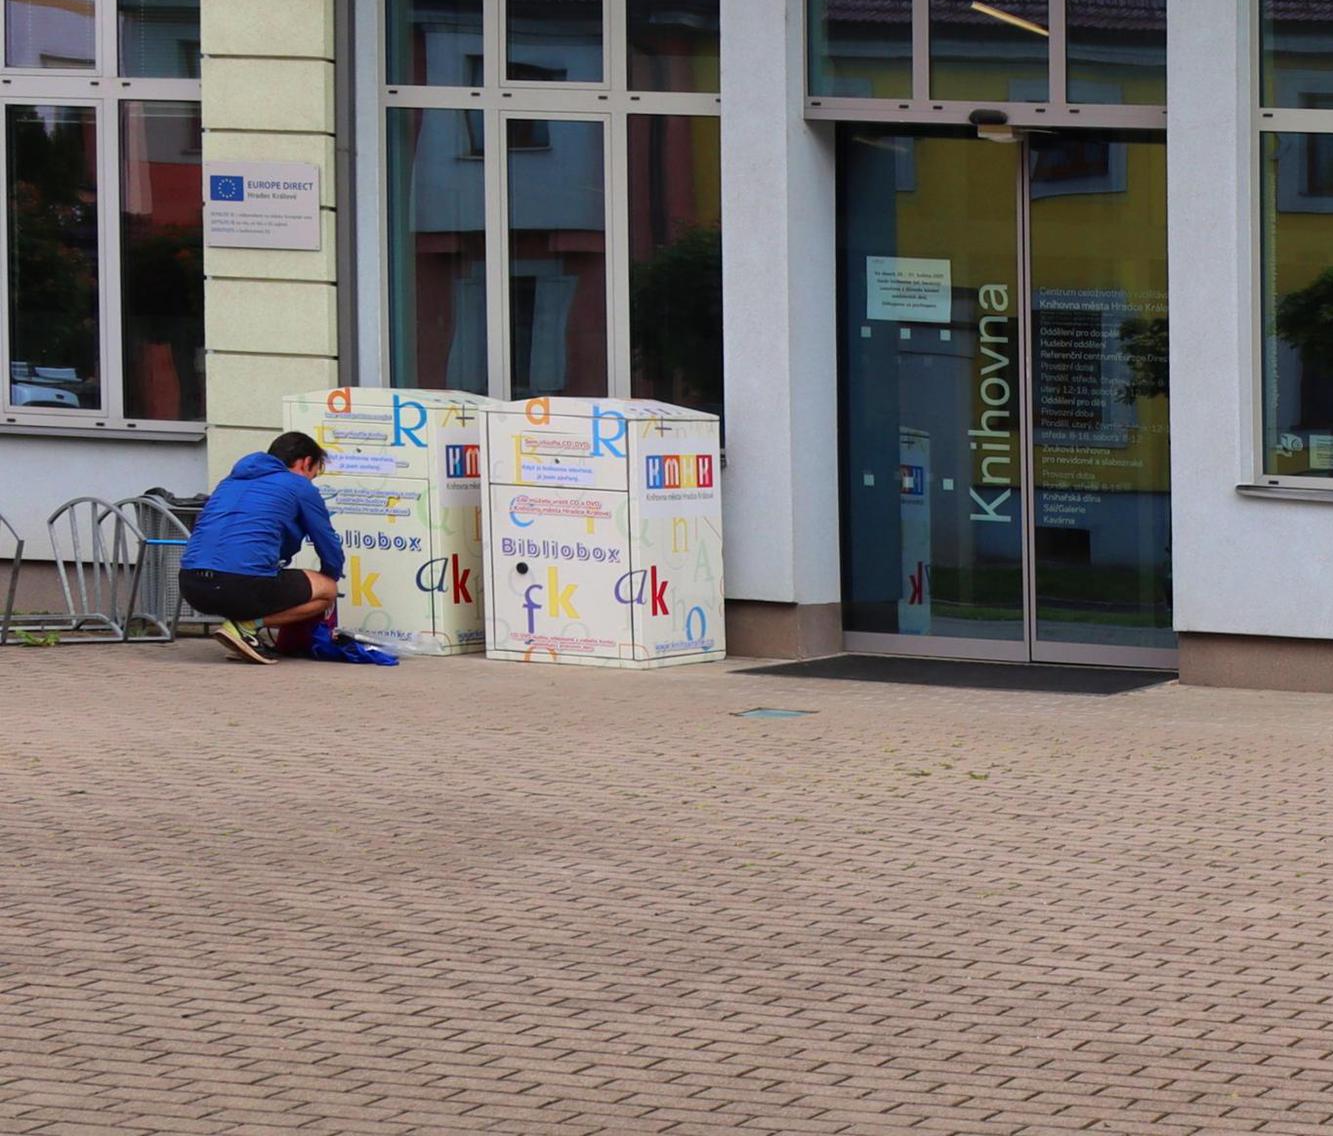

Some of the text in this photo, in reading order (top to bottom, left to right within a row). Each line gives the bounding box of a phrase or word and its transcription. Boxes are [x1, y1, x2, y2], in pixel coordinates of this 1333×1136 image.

[247, 180, 313, 191] EUROPE DIRECT
[1040, 300, 1078, 311] Knihovna
[1080, 301, 1109, 311] města
[1076, 331, 1089, 339] pro
[1040, 339, 1072, 349] Hudební
[968, 283, 1012, 523] Knihovna
[647, 456, 712, 488] KMHK
[1043, 516, 1076, 526] Kavárna
[501, 537, 621, 563] Bibliobox
